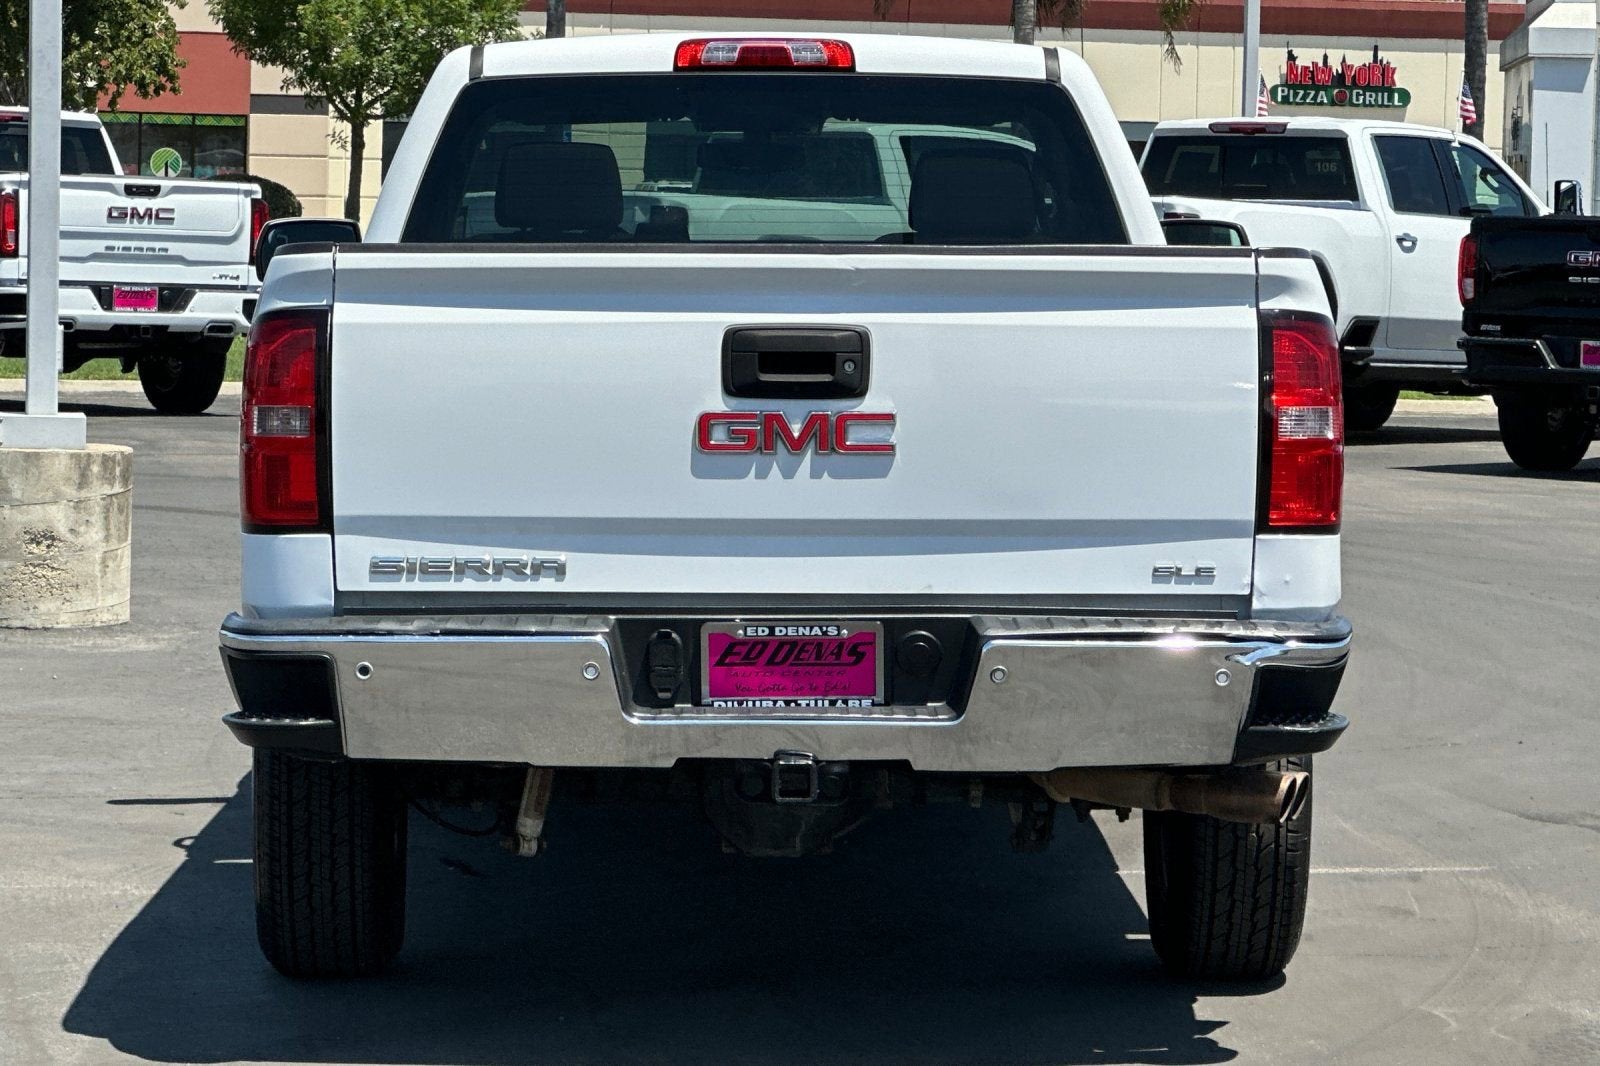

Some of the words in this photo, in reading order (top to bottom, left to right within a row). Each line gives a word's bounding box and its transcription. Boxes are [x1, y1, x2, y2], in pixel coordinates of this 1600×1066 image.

[1286, 60, 1333, 86] NEW
[1341, 61, 1398, 87] YORK
[1277, 86, 1328, 104] PIZZA
[1352, 88, 1403, 106] GRILL
[106, 206, 175, 222] GMC
[696, 410, 898, 456] GMC
[369, 555, 567, 578] SIERRA
[1152, 564, 1217, 580] SLE
[746, 626, 770, 636] ED
[774, 626, 839, 636] DENA'S
[713, 640, 769, 667] ED
[765, 640, 874, 667] DENA'S
